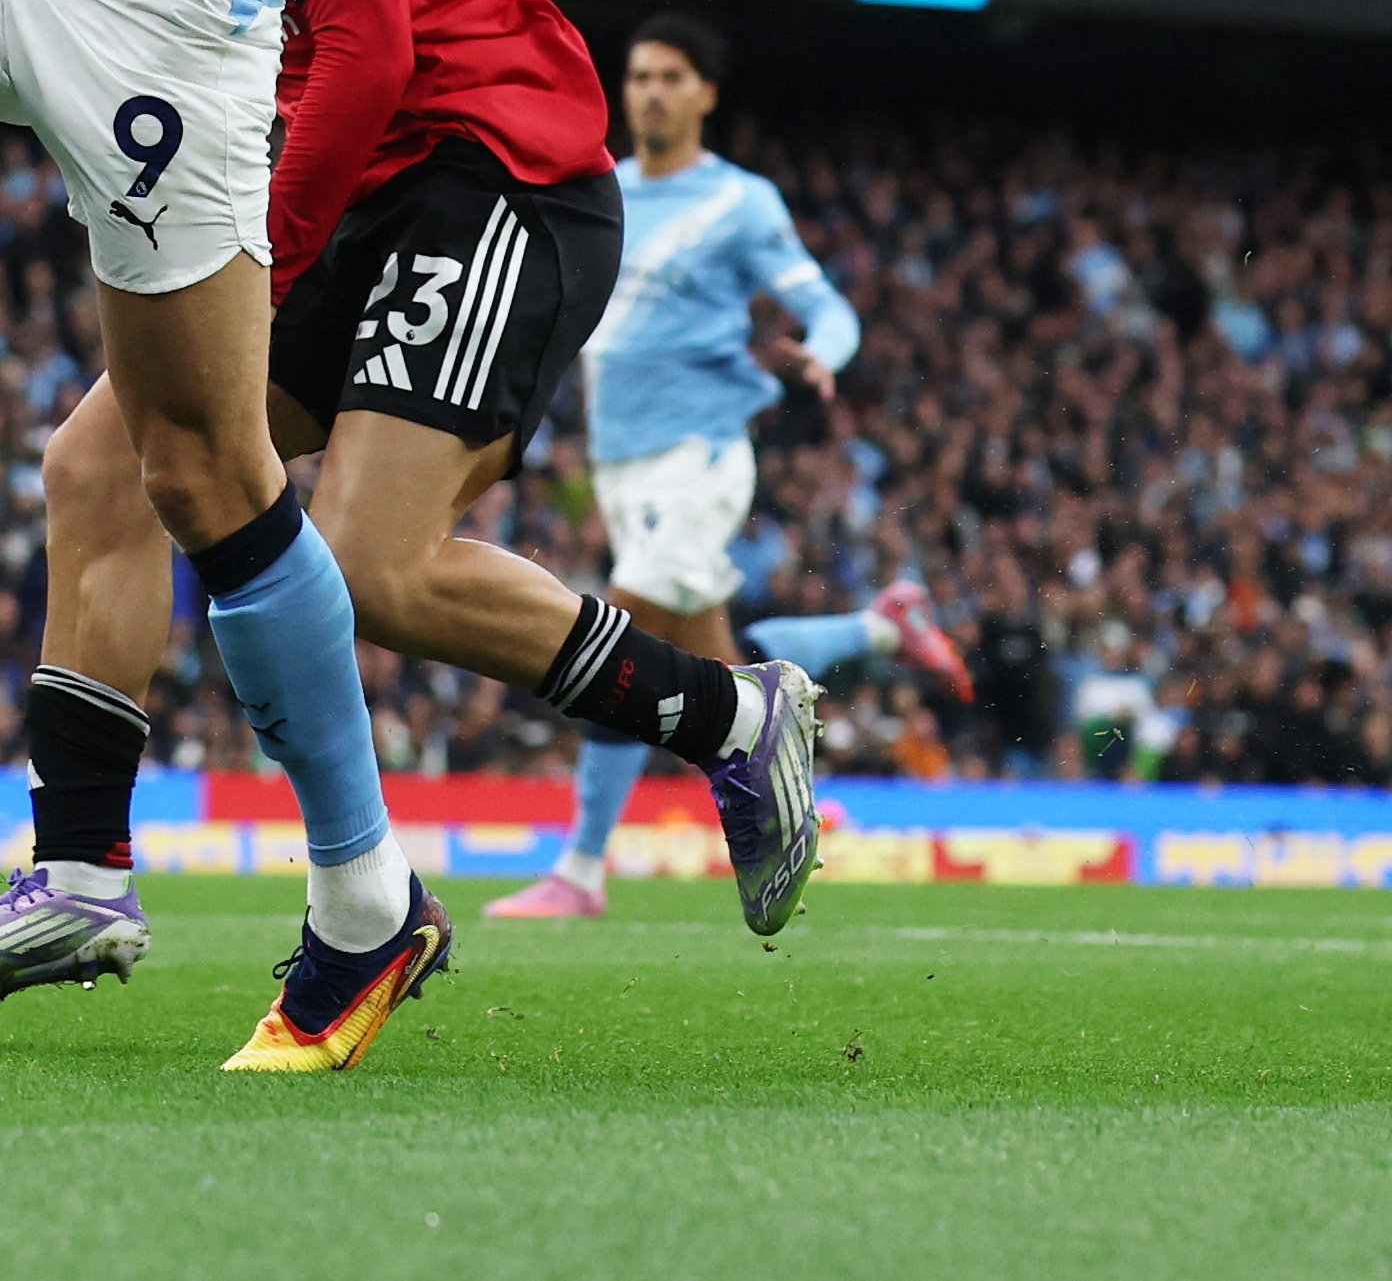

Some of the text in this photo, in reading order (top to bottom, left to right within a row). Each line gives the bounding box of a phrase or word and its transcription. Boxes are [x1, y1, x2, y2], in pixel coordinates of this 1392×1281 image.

[113, 95, 183, 198] 9
[354, 251, 464, 346] 23
[762, 834, 806, 922] F50
